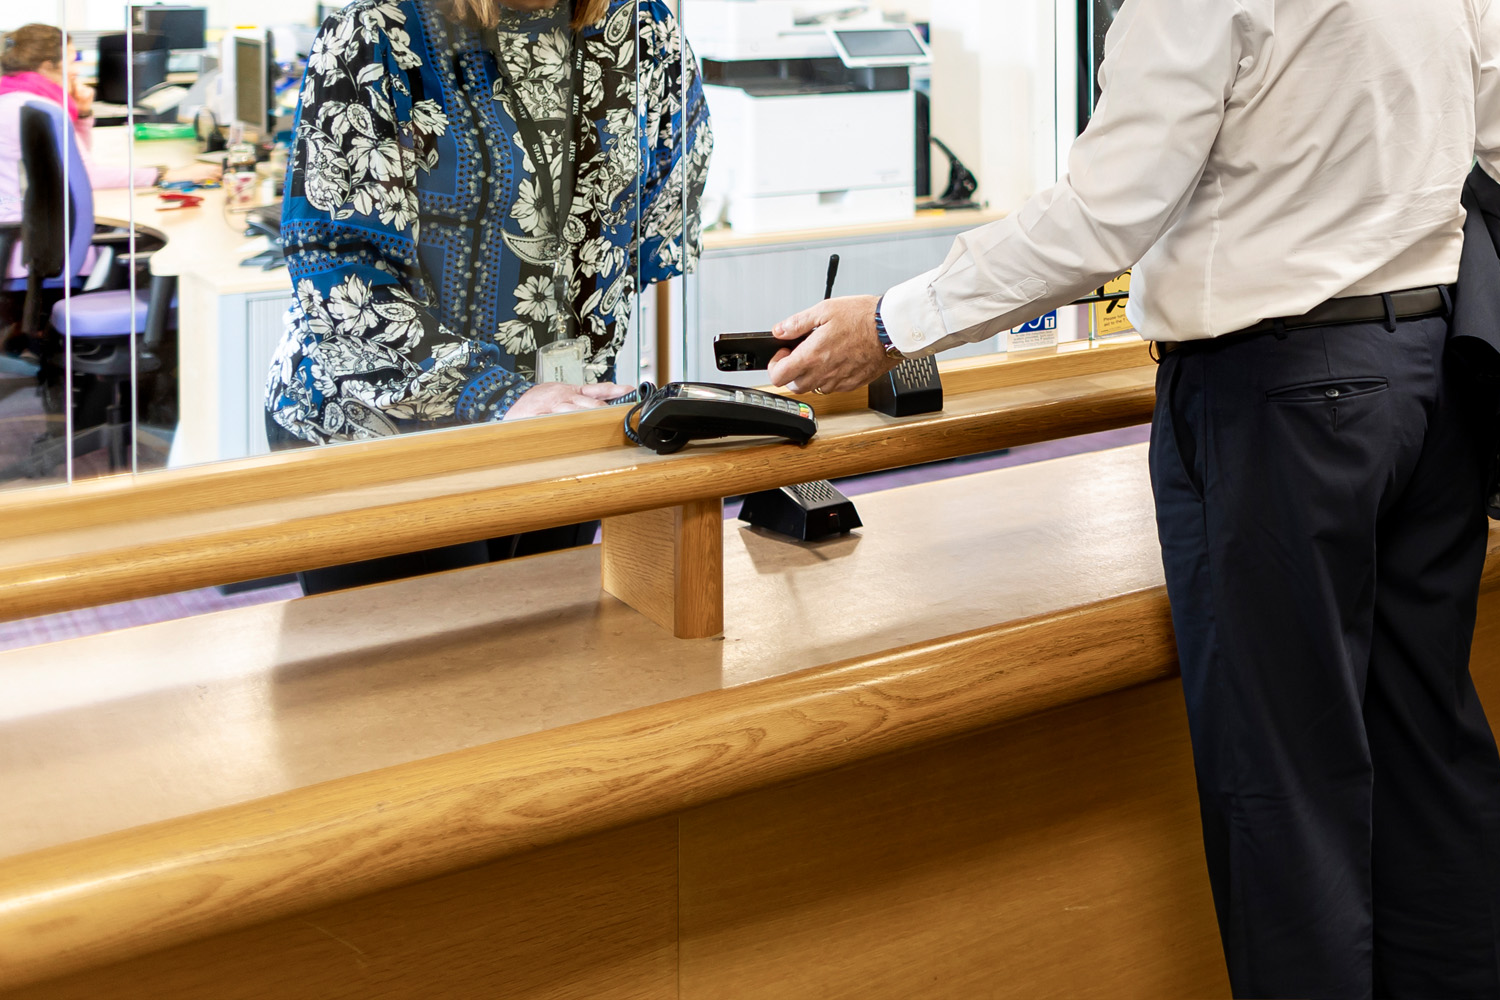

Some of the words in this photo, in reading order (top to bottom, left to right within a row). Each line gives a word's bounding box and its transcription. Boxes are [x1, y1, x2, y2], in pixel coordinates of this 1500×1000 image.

[572, 94, 580, 116] STAFF
[532, 143, 545, 165] STAFF
[568, 140, 576, 162] STAFF
[1046, 317, 1053, 327] T
